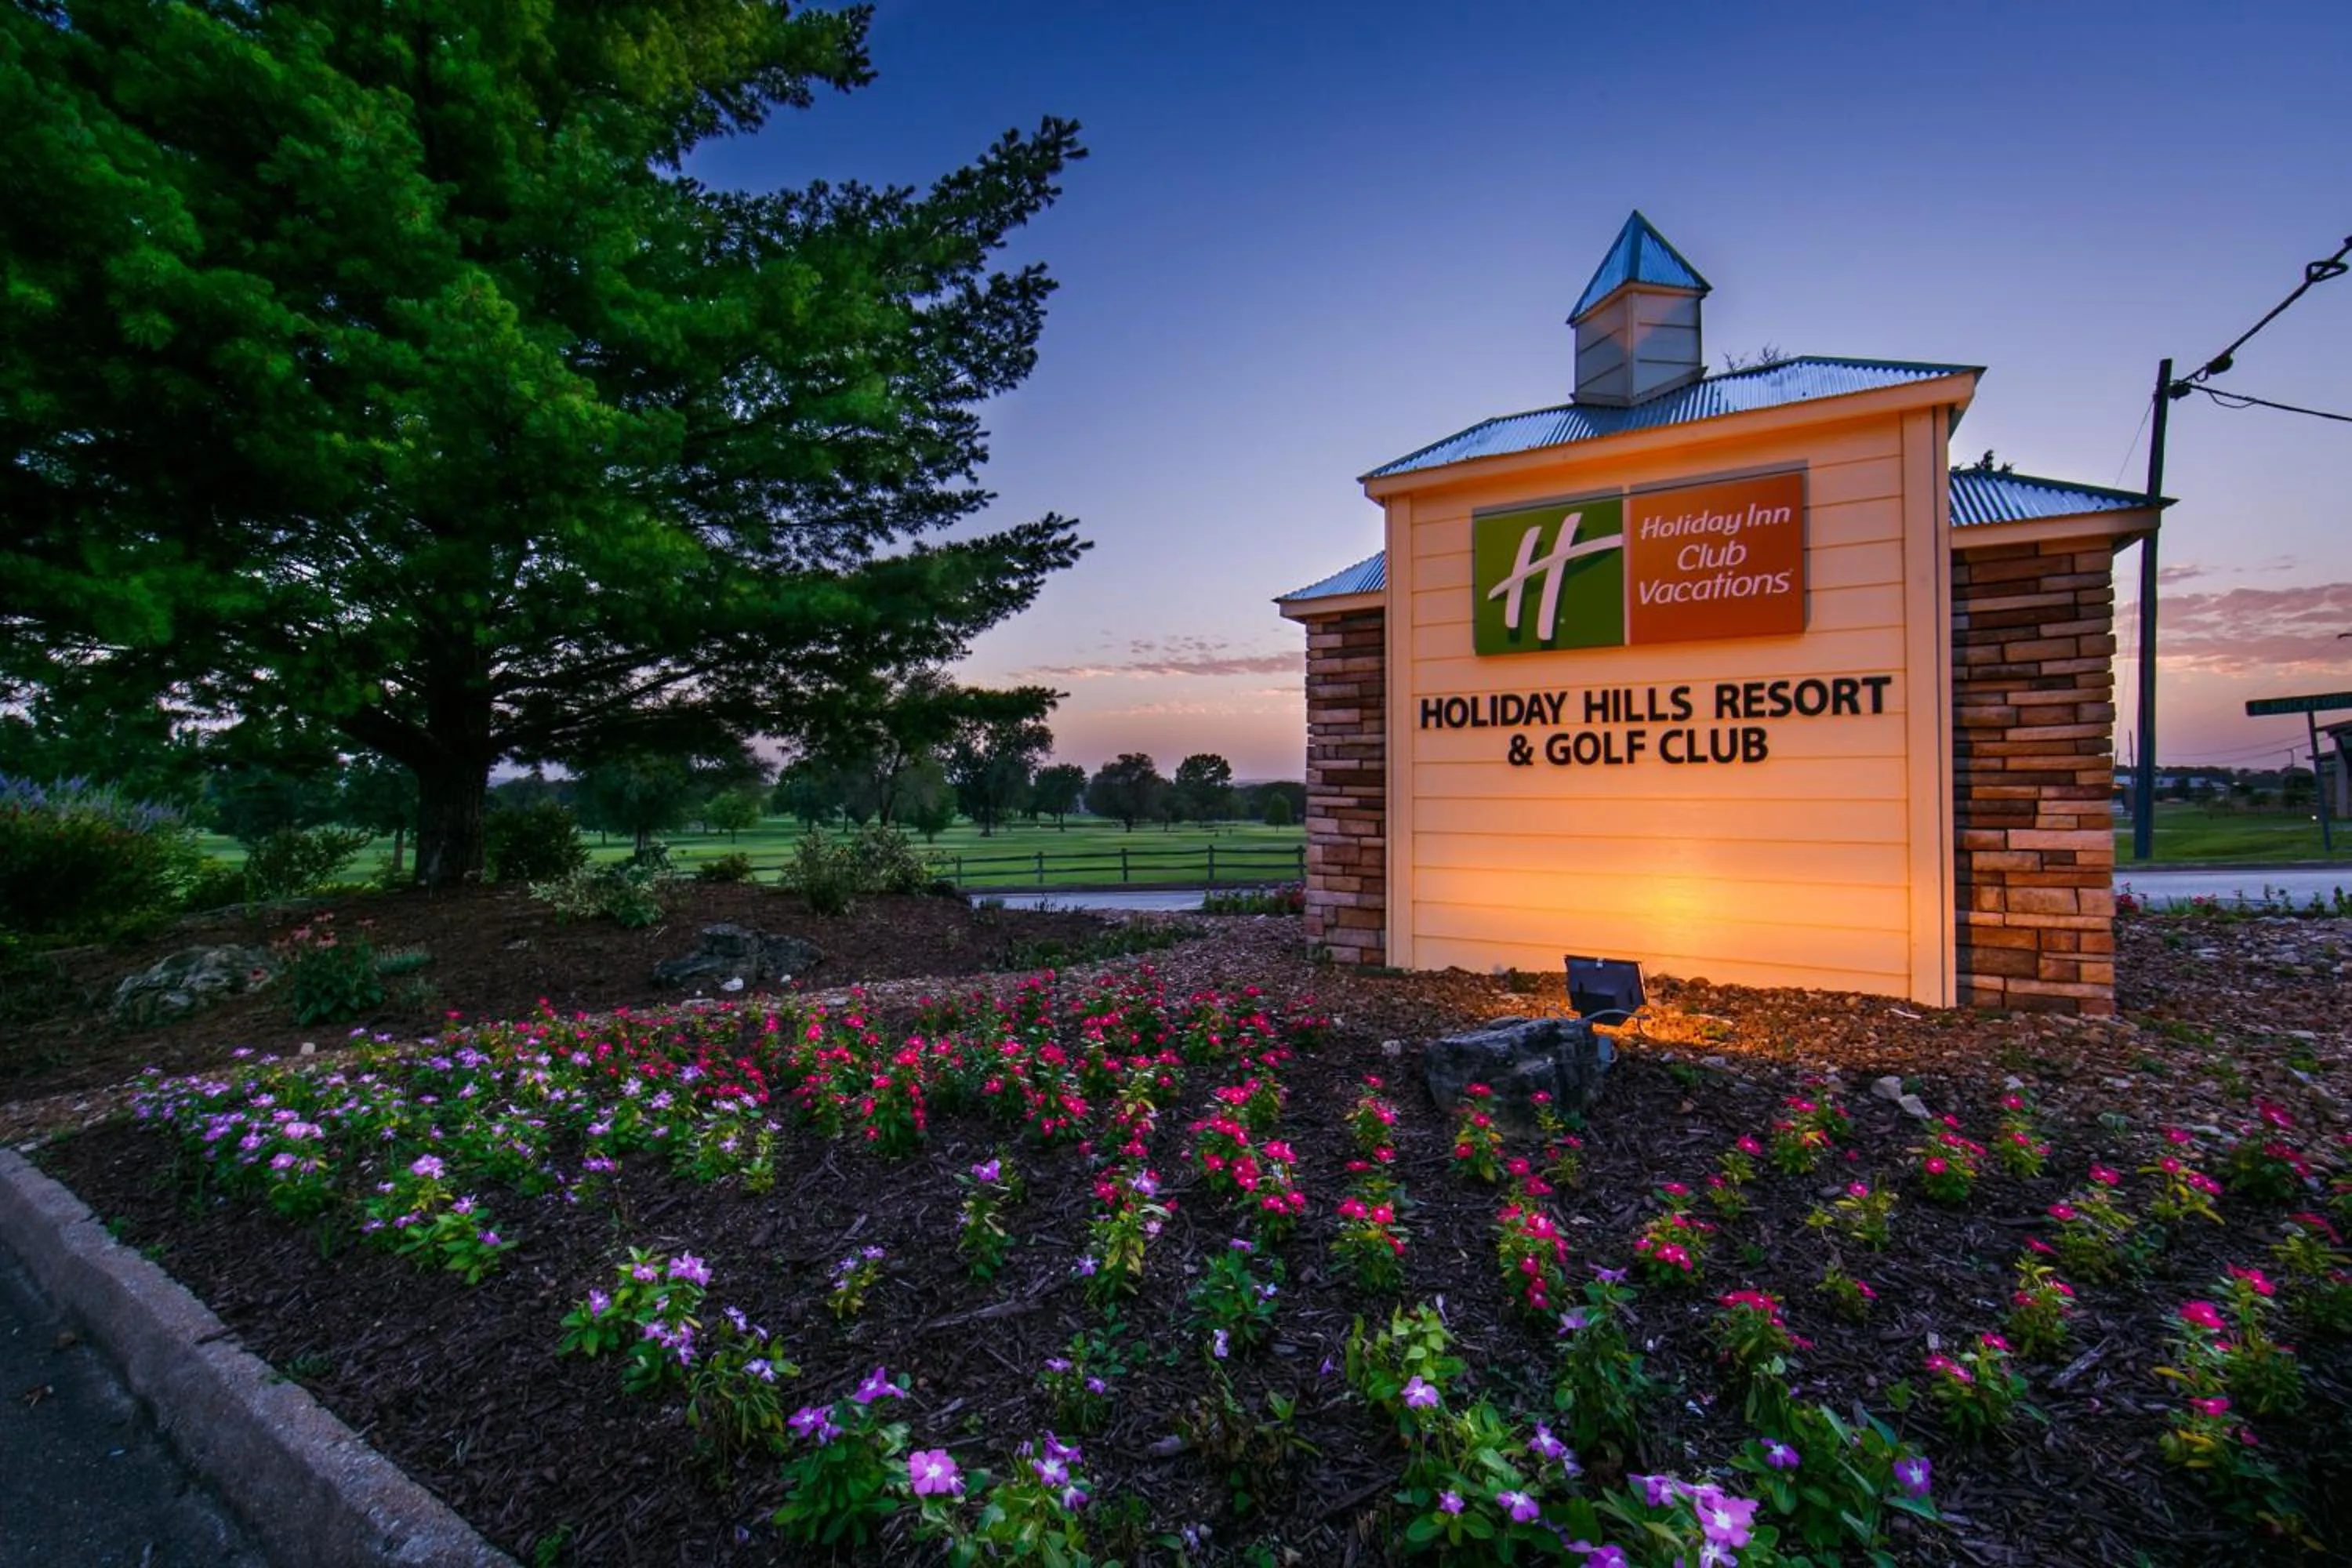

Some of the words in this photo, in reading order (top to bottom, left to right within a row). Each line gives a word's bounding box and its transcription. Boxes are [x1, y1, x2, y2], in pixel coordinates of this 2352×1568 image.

[1640, 509, 1743, 540] Holiday
[1746, 502, 1791, 528] Inn
[1676, 539, 1748, 572] Club
[1639, 571, 1794, 606] Vacations
[1420, 691, 1568, 729] HOLIDAY
[1584, 686, 1693, 723] HILLS
[1715, 676, 1892, 719] RESORT
[1508, 733, 1534, 766] &
[1545, 730, 1646, 766] GOLF
[1658, 726, 1769, 764] CLUB
